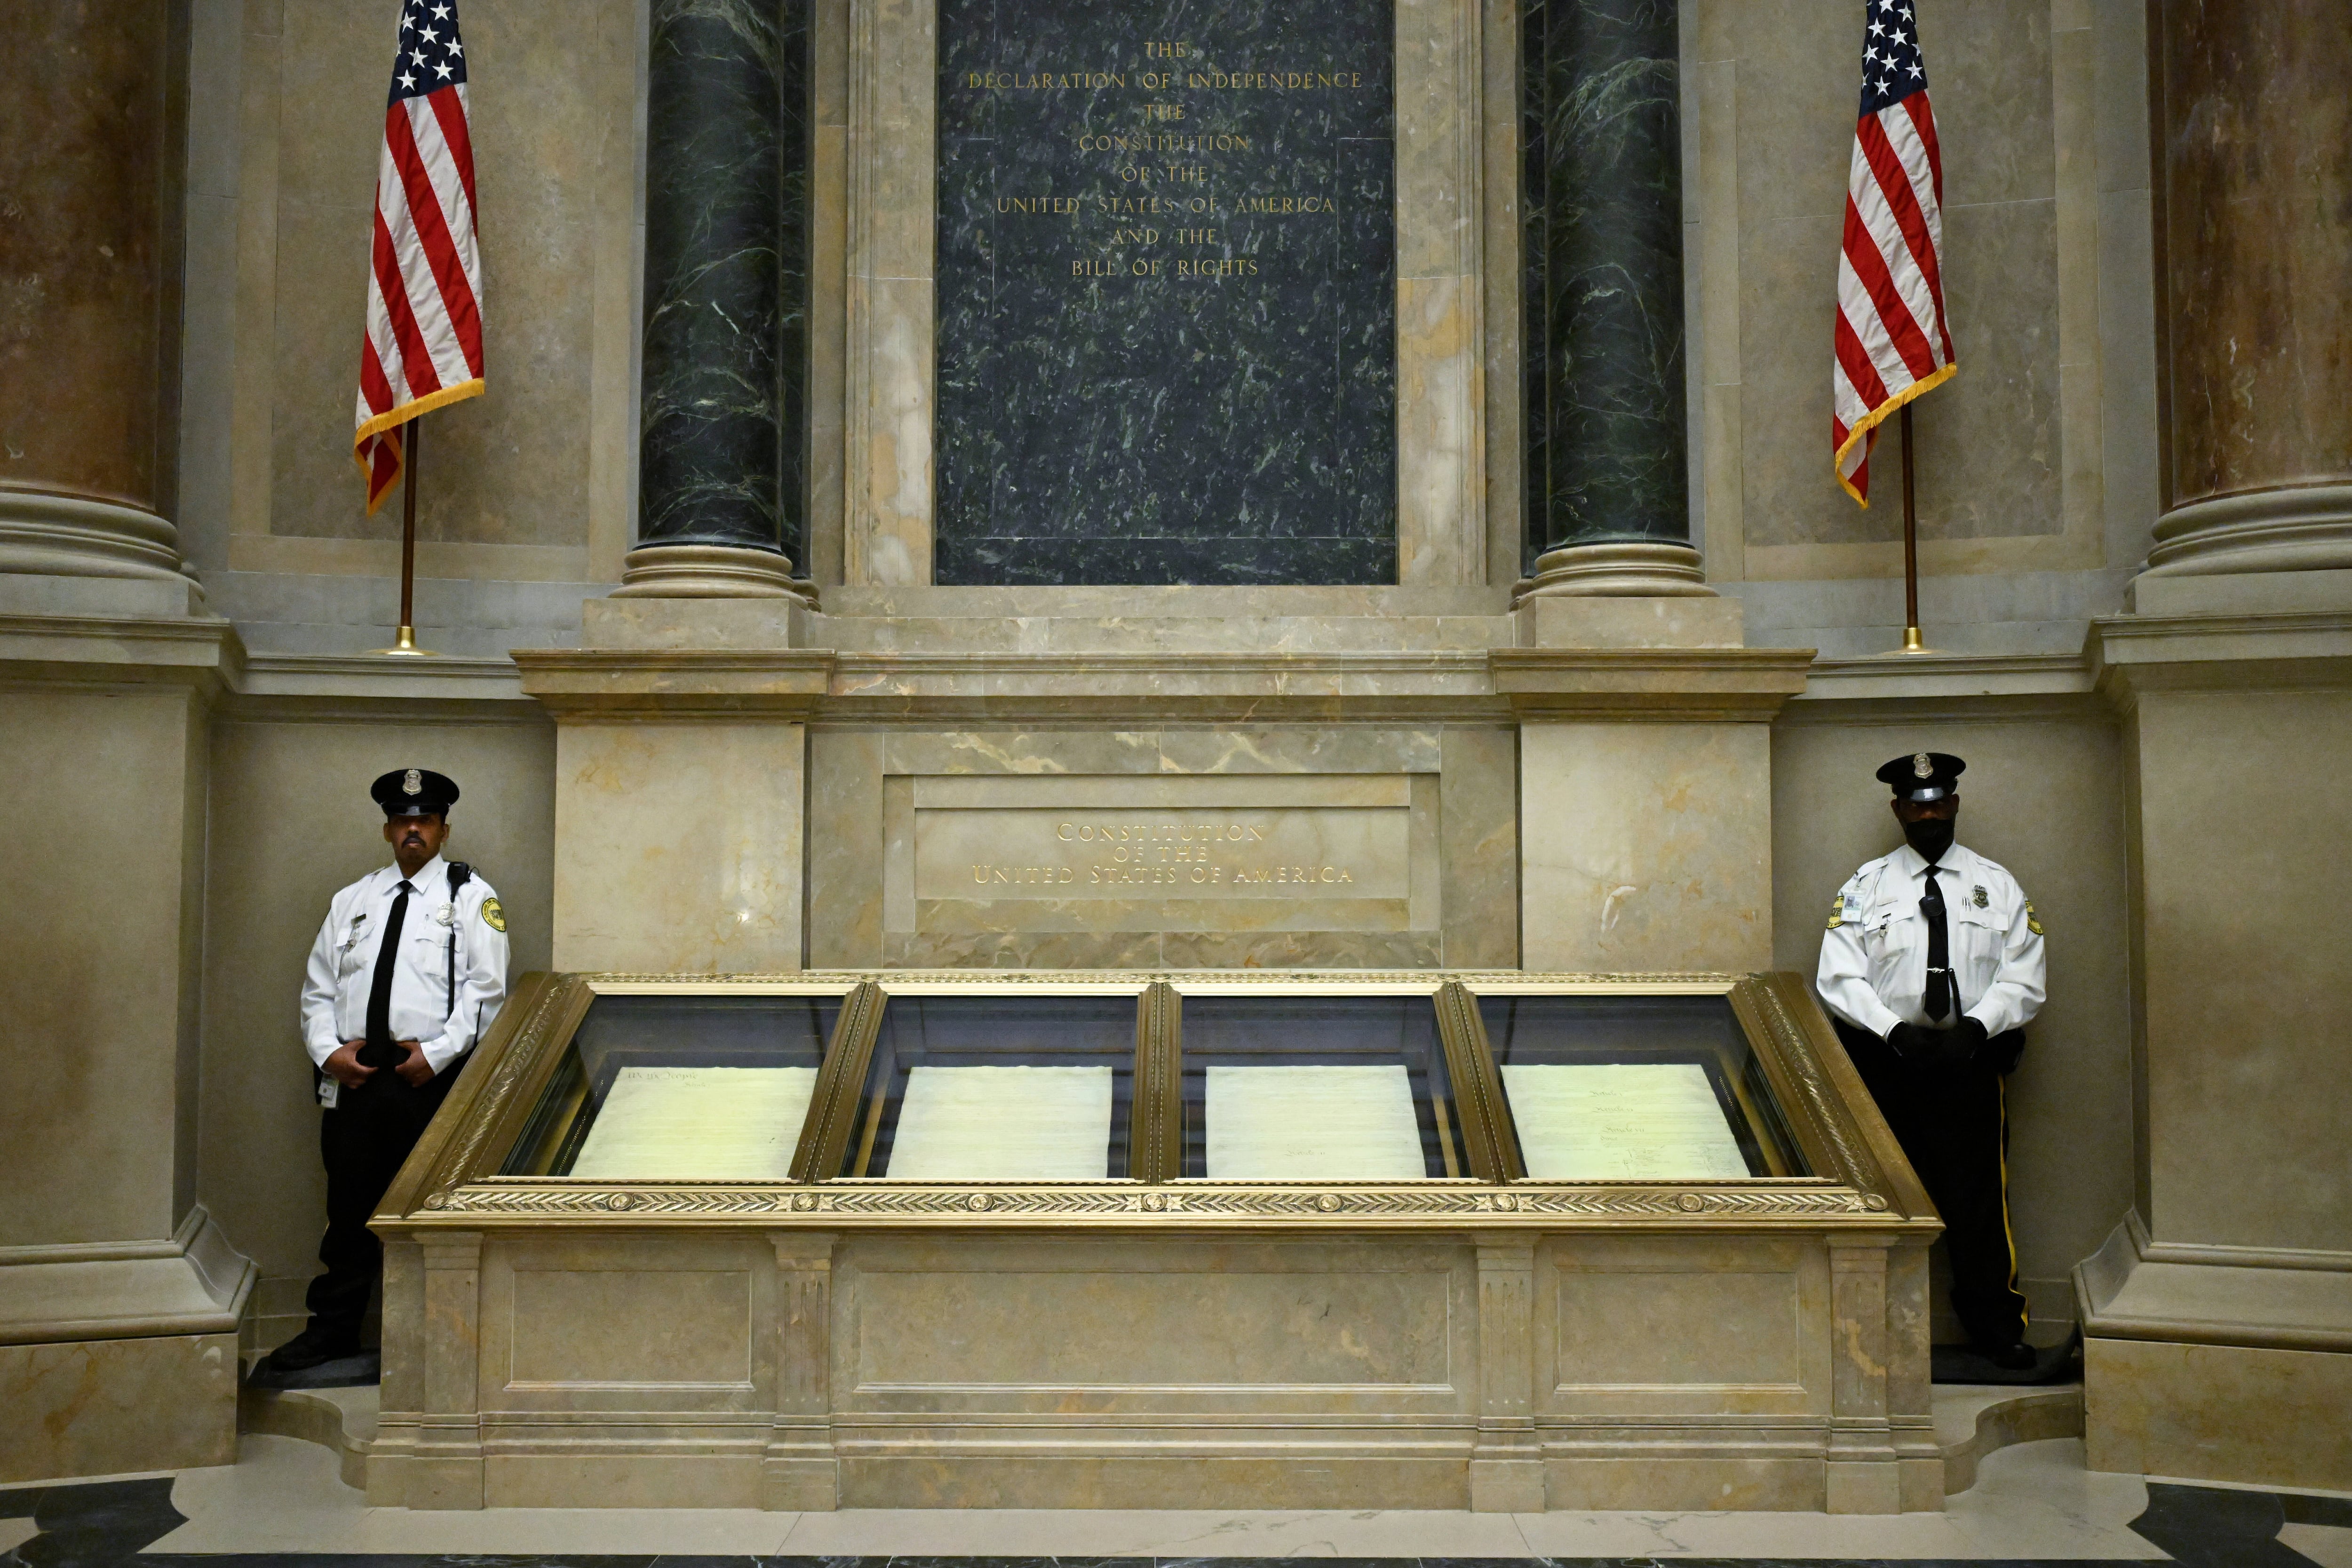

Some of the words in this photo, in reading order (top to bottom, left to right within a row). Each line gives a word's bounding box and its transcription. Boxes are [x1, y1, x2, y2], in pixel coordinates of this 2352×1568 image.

[1144, 42, 1185, 57] THE
[969, 73, 1125, 88] DECLARATION
[1143, 73, 1171, 88] OF
[1189, 72, 1362, 88] INDEPENDENCE
[1144, 104, 1185, 119] THE
[1079, 135, 1249, 151] CONSTITUTION
[1121, 167, 1150, 182] OF
[1166, 167, 1208, 182] THE
[997, 198, 1080, 213] UNITED
[1098, 198, 1173, 213] STATES
[1190, 198, 1218, 213] OF
[1234, 197, 1335, 213] AMERICA
[1112, 229, 1159, 245] AND
[1176, 229, 1217, 244] THE
[1072, 260, 1117, 276] BILL
[1132, 260, 1160, 276] OF
[1177, 260, 1258, 275] RIGHTS
[1057, 823, 1264, 842] CONSTITUTION
[1113, 846, 1144, 862] OF
[1158, 846, 1207, 862] THE
[972, 866, 1073, 883] UNITED
[1090, 866, 1176, 883] STATES
[1190, 867, 1221, 883] OF
[1232, 867, 1353, 883] AMERICA
